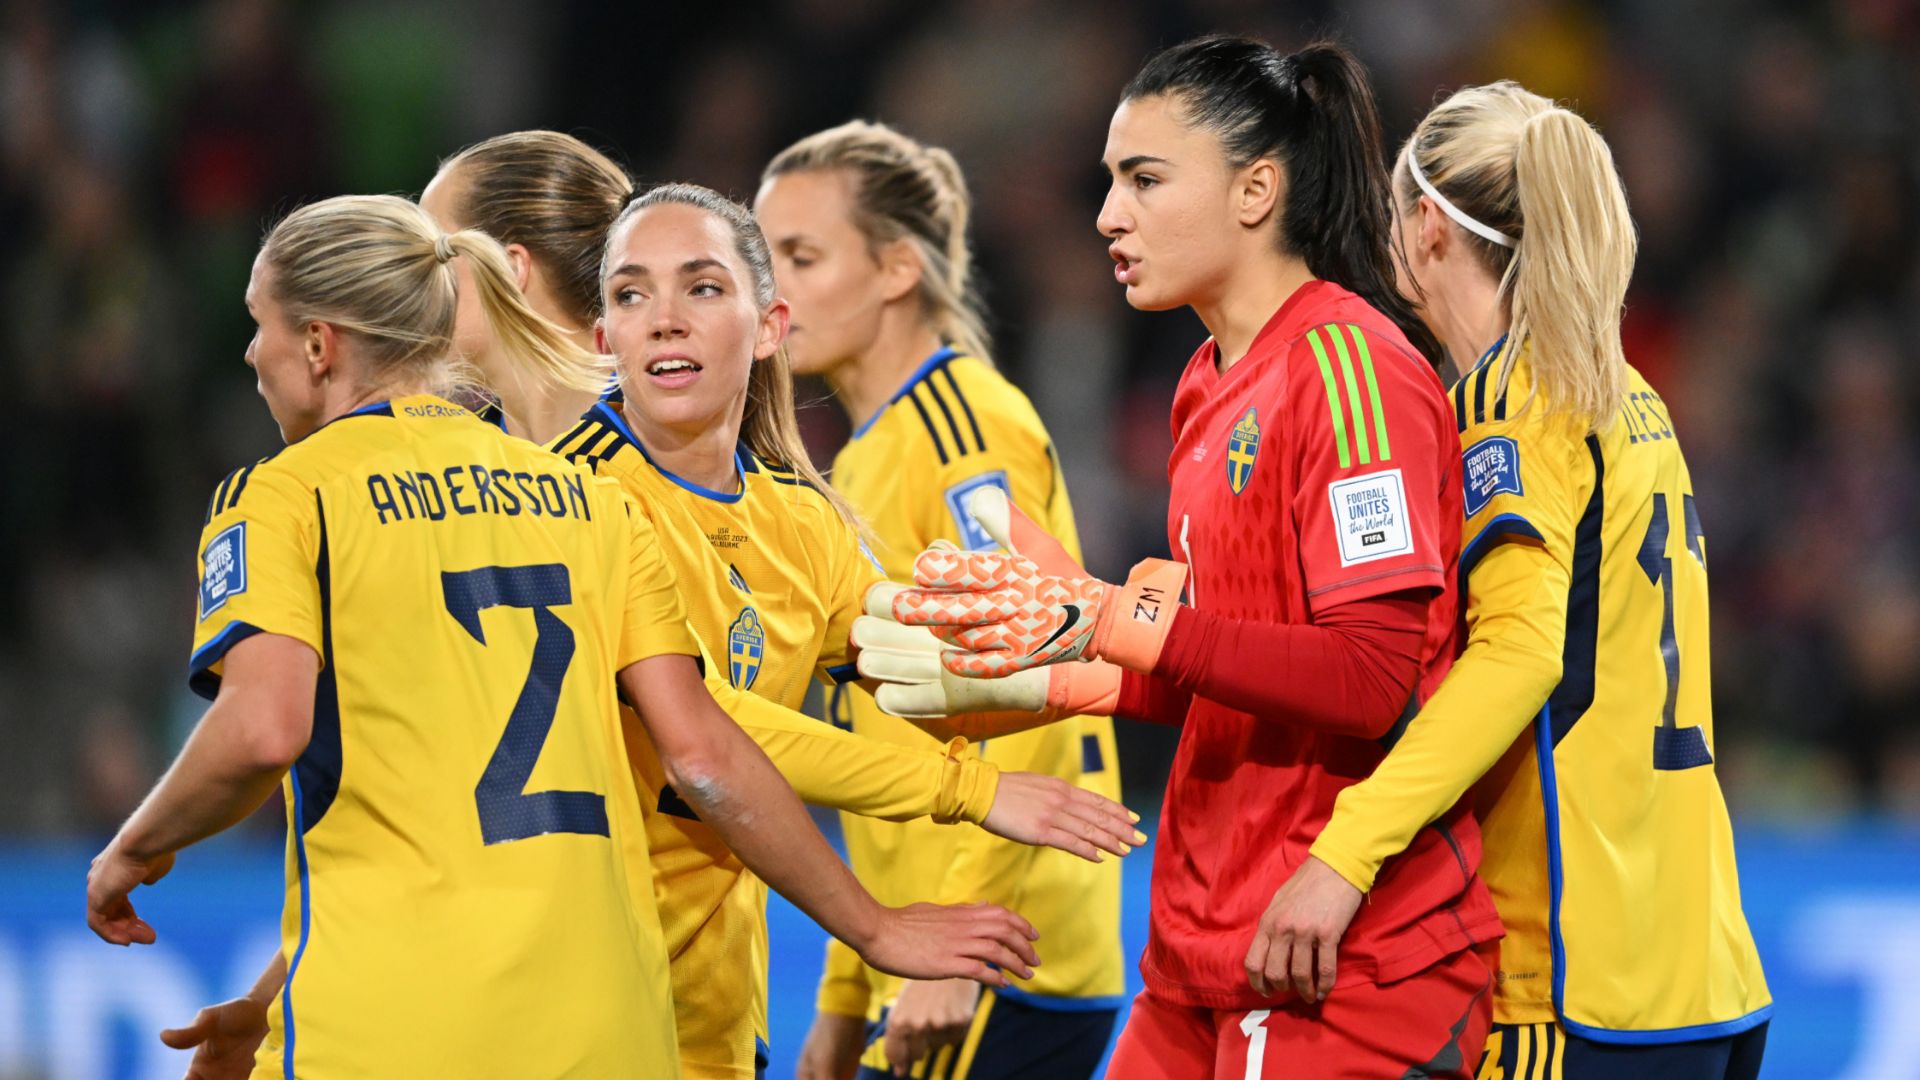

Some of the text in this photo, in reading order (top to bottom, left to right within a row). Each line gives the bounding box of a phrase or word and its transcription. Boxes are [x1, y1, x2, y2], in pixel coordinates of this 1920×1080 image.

[1467, 445, 1505, 469] FOOTBALL
[1469, 452, 1506, 480] UNITES
[367, 464, 591, 525] ANDERSSON
[1346, 486, 1388, 505] FOOTBALL
[1348, 498, 1390, 520] UNITES
[1349, 513, 1394, 534] the World
[1363, 533, 1384, 544] FIFA
[1133, 587, 1165, 623] ZM
[441, 563, 610, 847] 2
[1239, 1008, 1272, 1080] 1
